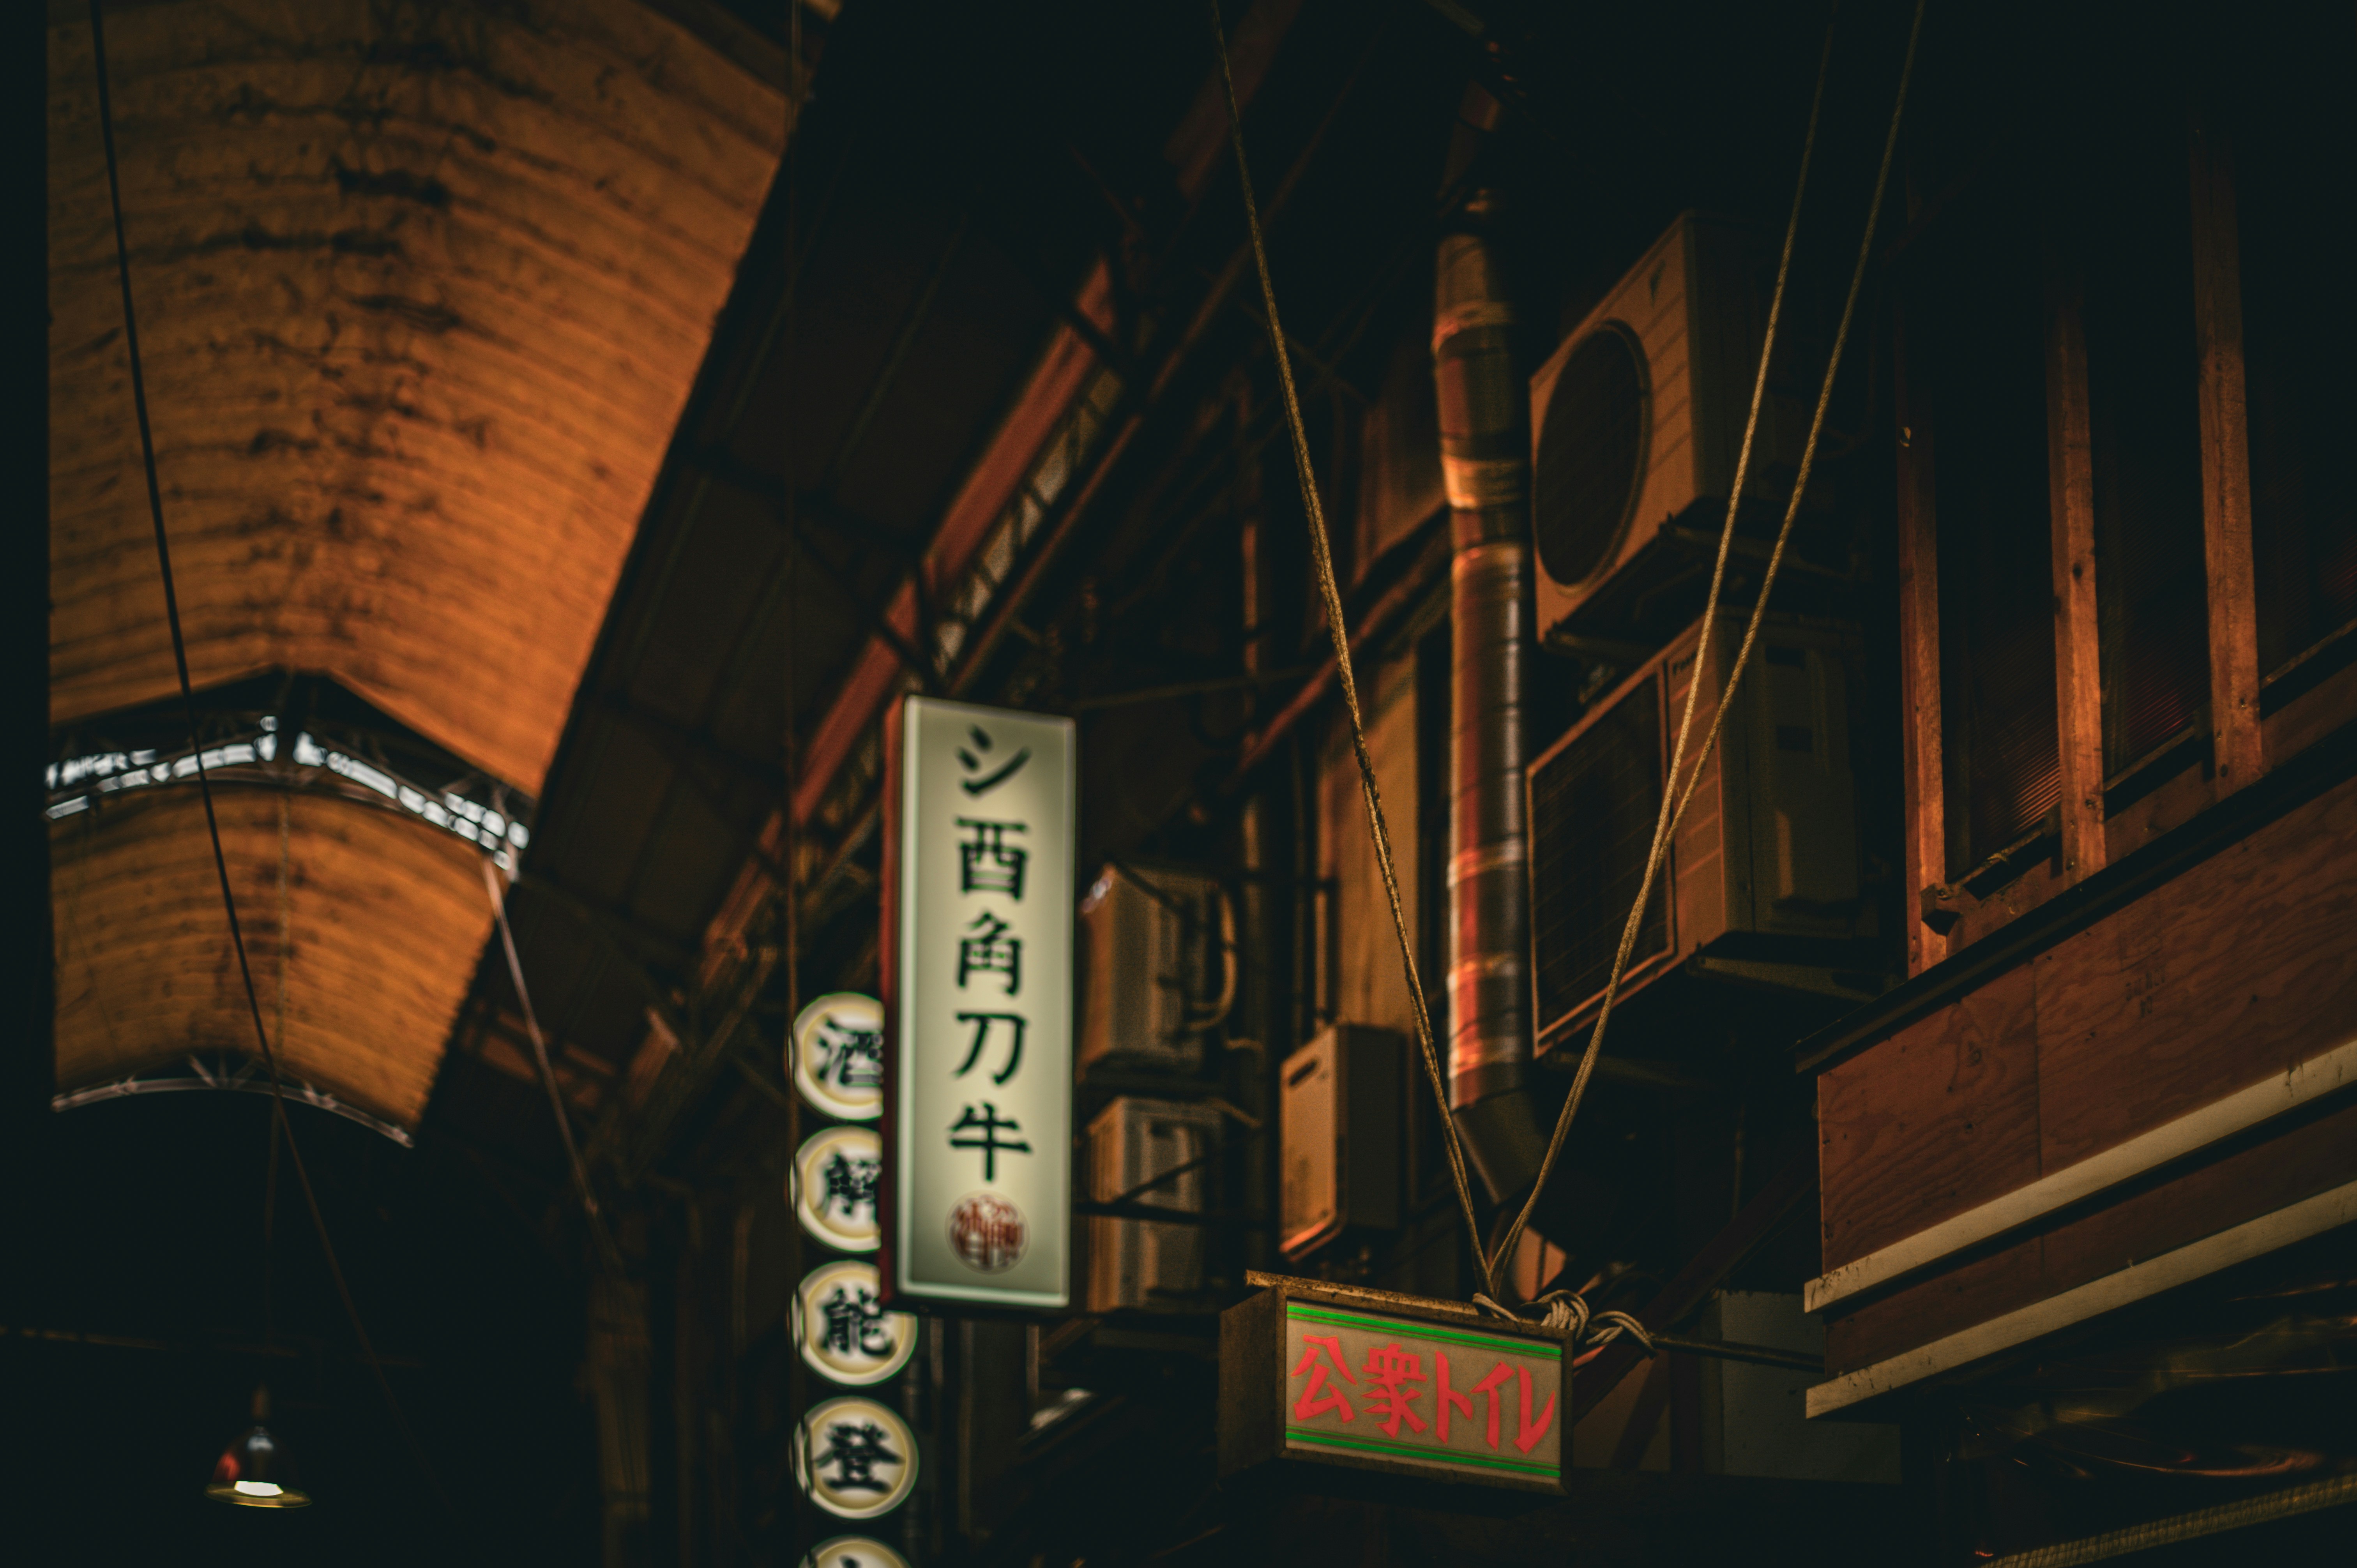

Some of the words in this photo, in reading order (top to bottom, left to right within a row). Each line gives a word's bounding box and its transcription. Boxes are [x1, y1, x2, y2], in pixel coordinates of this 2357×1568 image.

[814, 1016, 903, 1568] 酒解能登
[1291, 1335, 1555, 1454] 公衆トイレ
